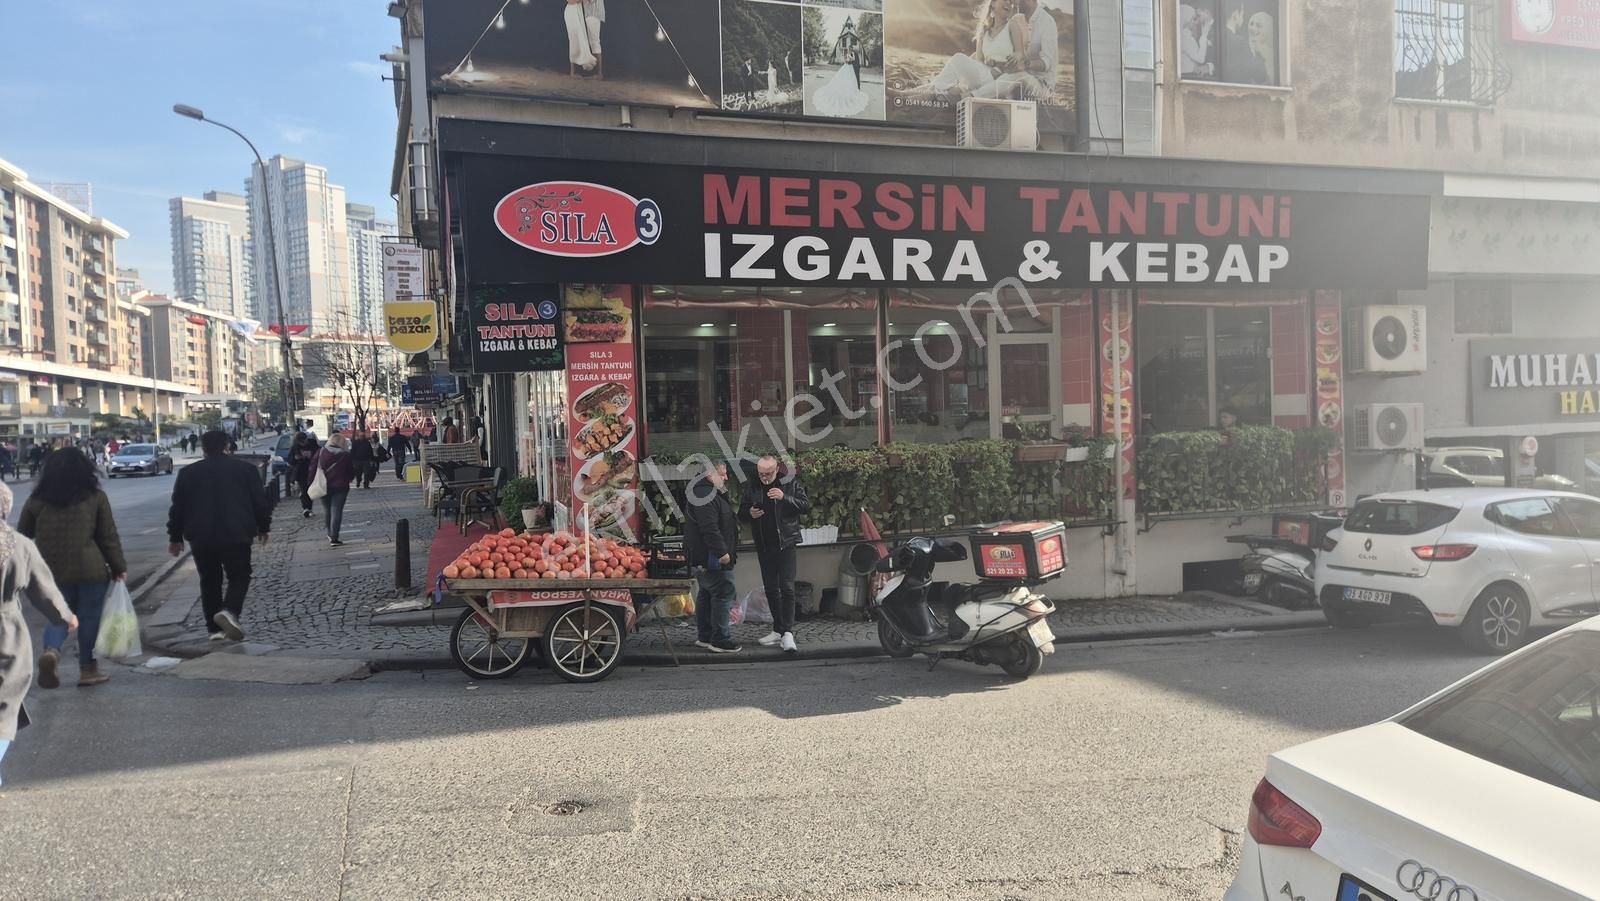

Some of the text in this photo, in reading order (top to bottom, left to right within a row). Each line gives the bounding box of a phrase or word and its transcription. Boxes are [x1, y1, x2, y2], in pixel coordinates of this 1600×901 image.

[540, 208, 659, 245] SILA 3
[703, 232, 1289, 283] IZGARA & KEBAP
[388, 315, 421, 326] taze
[484, 303, 553, 321] SILA 3
[479, 338, 558, 352] IZGARA & KEBAP
[589, 351, 607, 359] SILA
[571, 374, 599, 382] IZGARA
[608, 373, 633, 381] KEBAP
[1490, 353, 1600, 388] MUHA
[1561, 390, 1600, 415] HA
